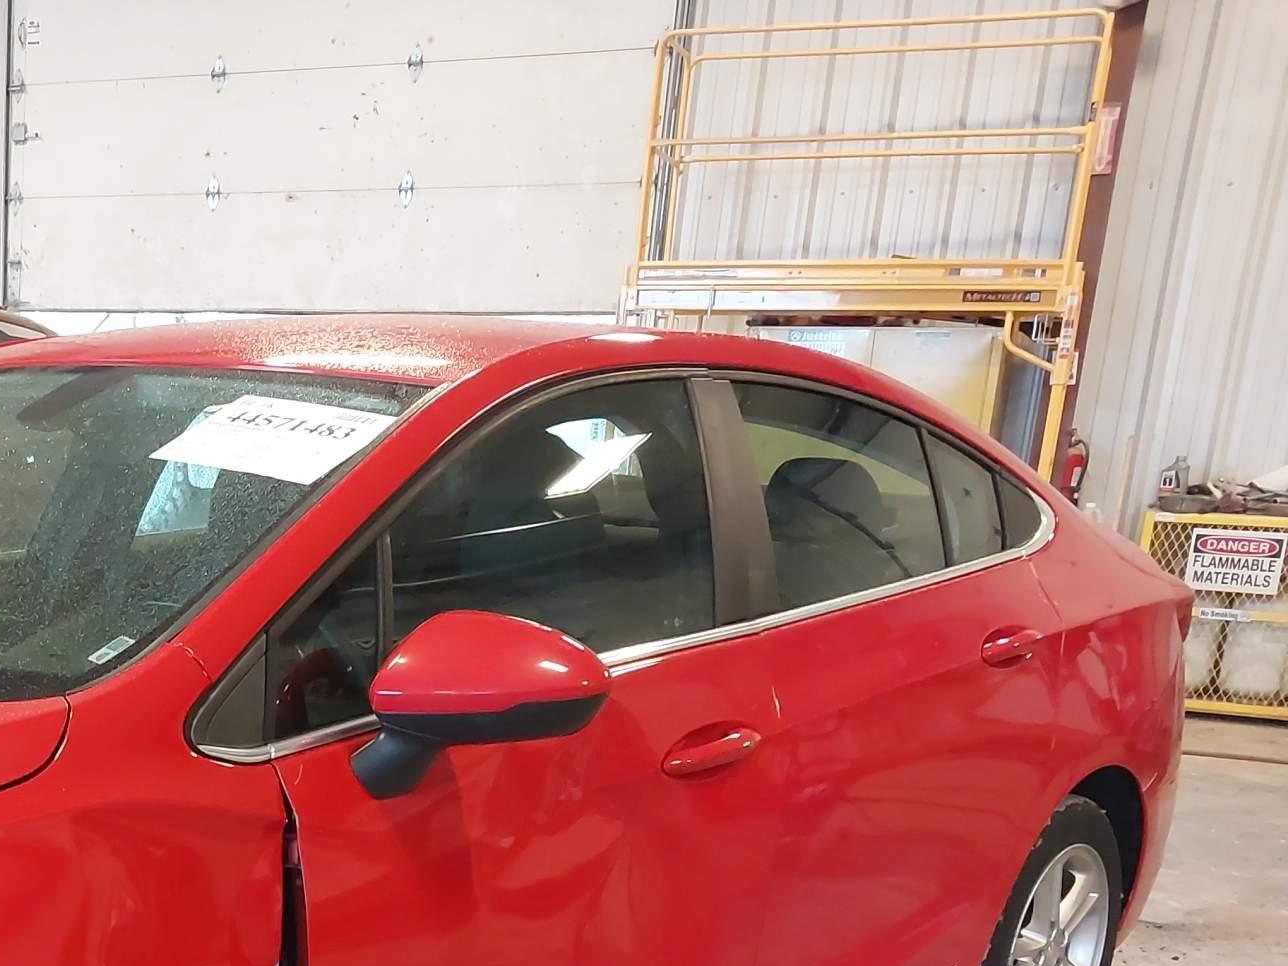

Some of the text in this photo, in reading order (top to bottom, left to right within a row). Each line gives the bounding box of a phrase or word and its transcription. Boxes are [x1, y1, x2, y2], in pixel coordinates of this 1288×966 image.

[227, 410, 356, 440] 44571483
[1206, 539, 1270, 554] DANGER
[1192, 555, 1277, 573] FLAMMABLE
[1192, 570, 1272, 588] MATERIALS
[1200, 609, 1239, 620] No Smoking
